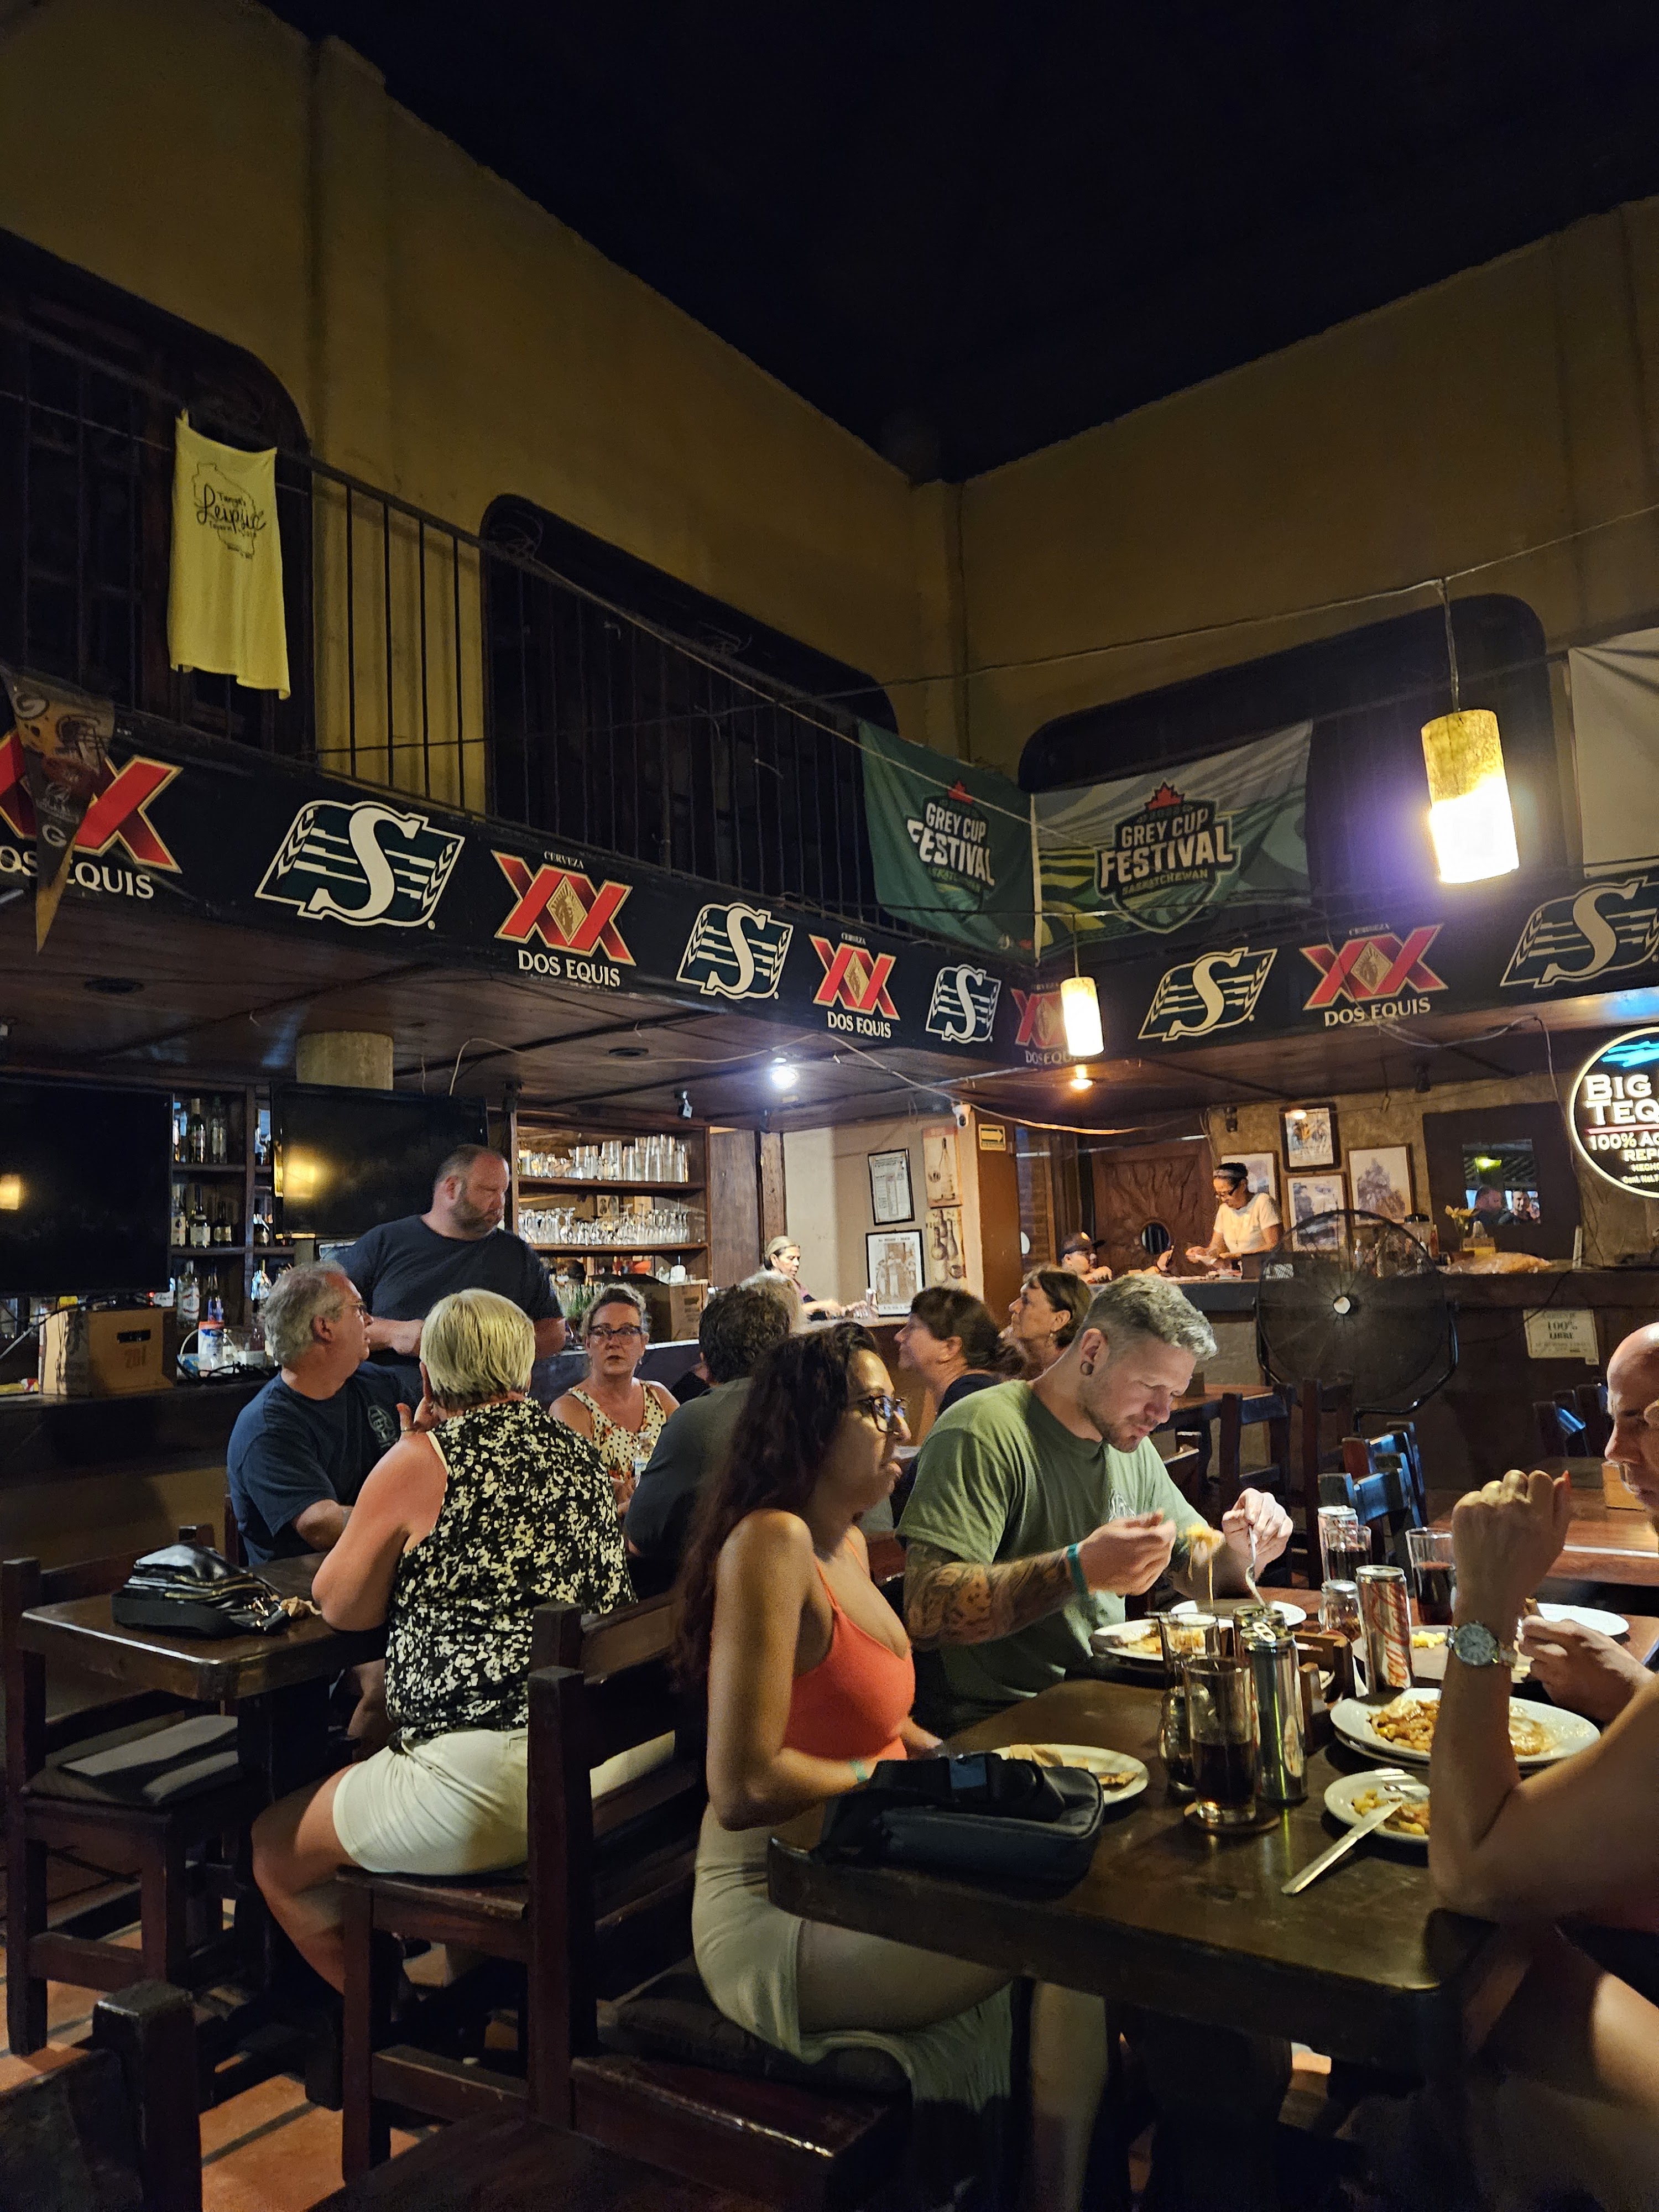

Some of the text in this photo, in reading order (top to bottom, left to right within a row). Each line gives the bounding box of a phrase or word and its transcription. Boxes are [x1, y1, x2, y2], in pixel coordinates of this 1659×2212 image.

[926, 802, 987, 844] GREY CUP
[1121, 820, 1167, 848] GREY
[1172, 807, 1209, 837] CUP
[907, 818, 995, 886] FESTIVAL
[1100, 825, 1233, 889] FESTIVAL
[0, 846, 154, 899] OS QUIS
[518, 950, 561, 977] DOS
[566, 959, 620, 988] EQUIS
[827, 1011, 891, 1039] DOS EQUIS
[1324, 997, 1431, 1027] DOS EQUIS
[1044, 1051, 1078, 1065] EQU
[1584, 1074, 1652, 1101] BIG
[1589, 1131, 1637, 1151] 100%
[1623, 1147, 1659, 1162] REP
